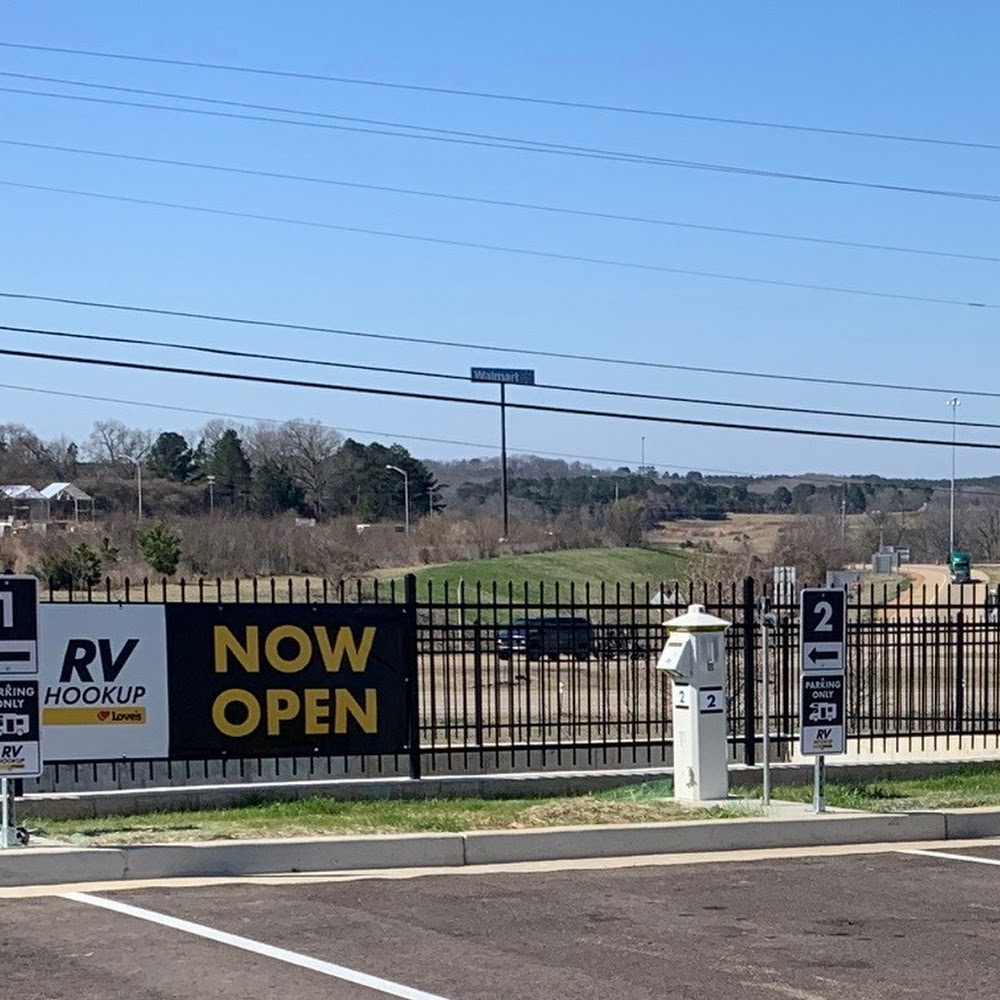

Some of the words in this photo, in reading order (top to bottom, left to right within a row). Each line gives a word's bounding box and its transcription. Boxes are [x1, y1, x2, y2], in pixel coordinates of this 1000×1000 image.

[473, 370, 520, 382] Walmart
[813, 601, 833, 632] 2
[213, 625, 377, 673] NOW
[59, 638, 140, 682] RV
[805, 680, 841, 689] PARKING
[0, 687, 35, 696] RKING
[44, 686, 146, 705] HOOKUP
[679, 690, 685, 703] 2
[812, 690, 834, 698] ONLY
[0, 699, 24, 708] NLY
[707, 694, 716, 708] 2
[112, 710, 142, 722] Love's
[212, 688, 378, 737] OPEN
[816, 729, 832, 740] RV
[2, 745, 23, 758] RV
